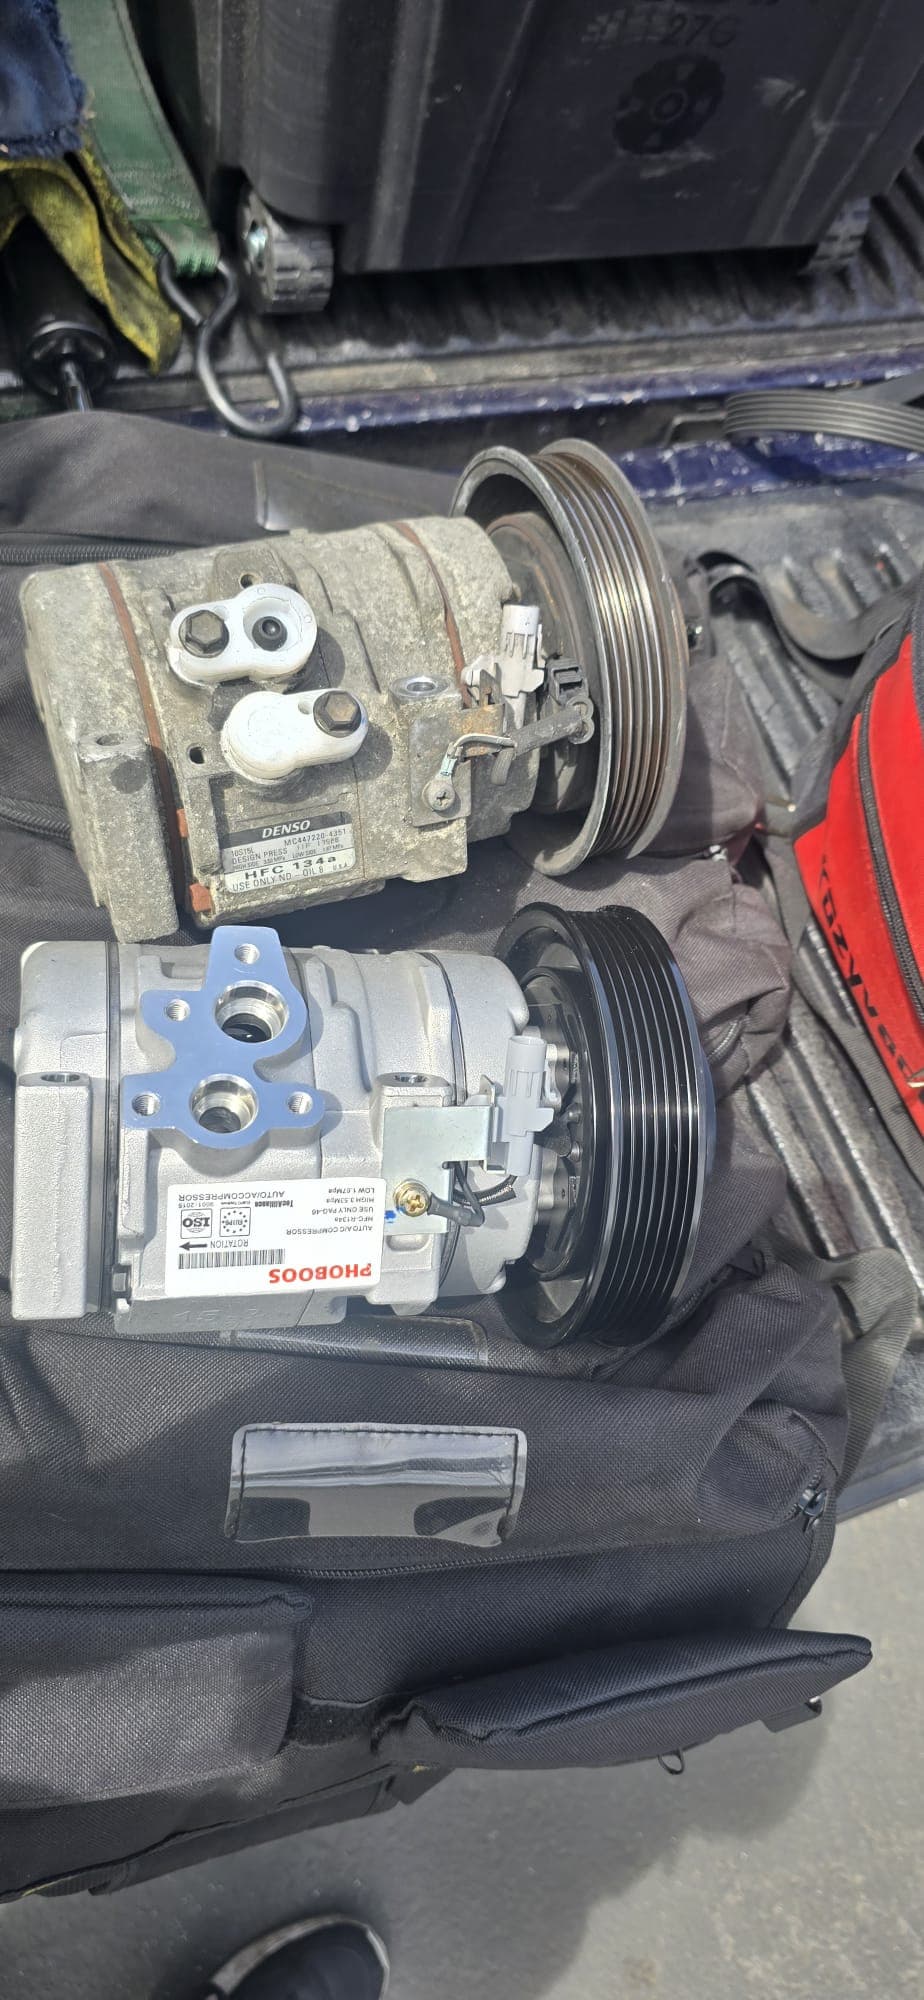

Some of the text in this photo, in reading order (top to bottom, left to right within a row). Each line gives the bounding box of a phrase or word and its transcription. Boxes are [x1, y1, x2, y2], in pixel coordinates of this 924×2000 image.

[261, 819, 311, 839] DENSO
[232, 847, 288, 865] DESIGN PRESS
[245, 856, 336, 880] HFC 134a
[232, 880, 251, 892] USE
[253, 876, 275, 888] ONLY
[178, 1190, 286, 1202] AUTO/ACCOMPRESSOR
[182, 1217, 211, 1228] ISO
[352, 1225, 373, 1233] AUTO
[286, 1226, 339, 1236] COMPRESSOR
[210, 1239, 249, 1249] ROTATION
[268, 1262, 372, 1284] PHOBOOS
